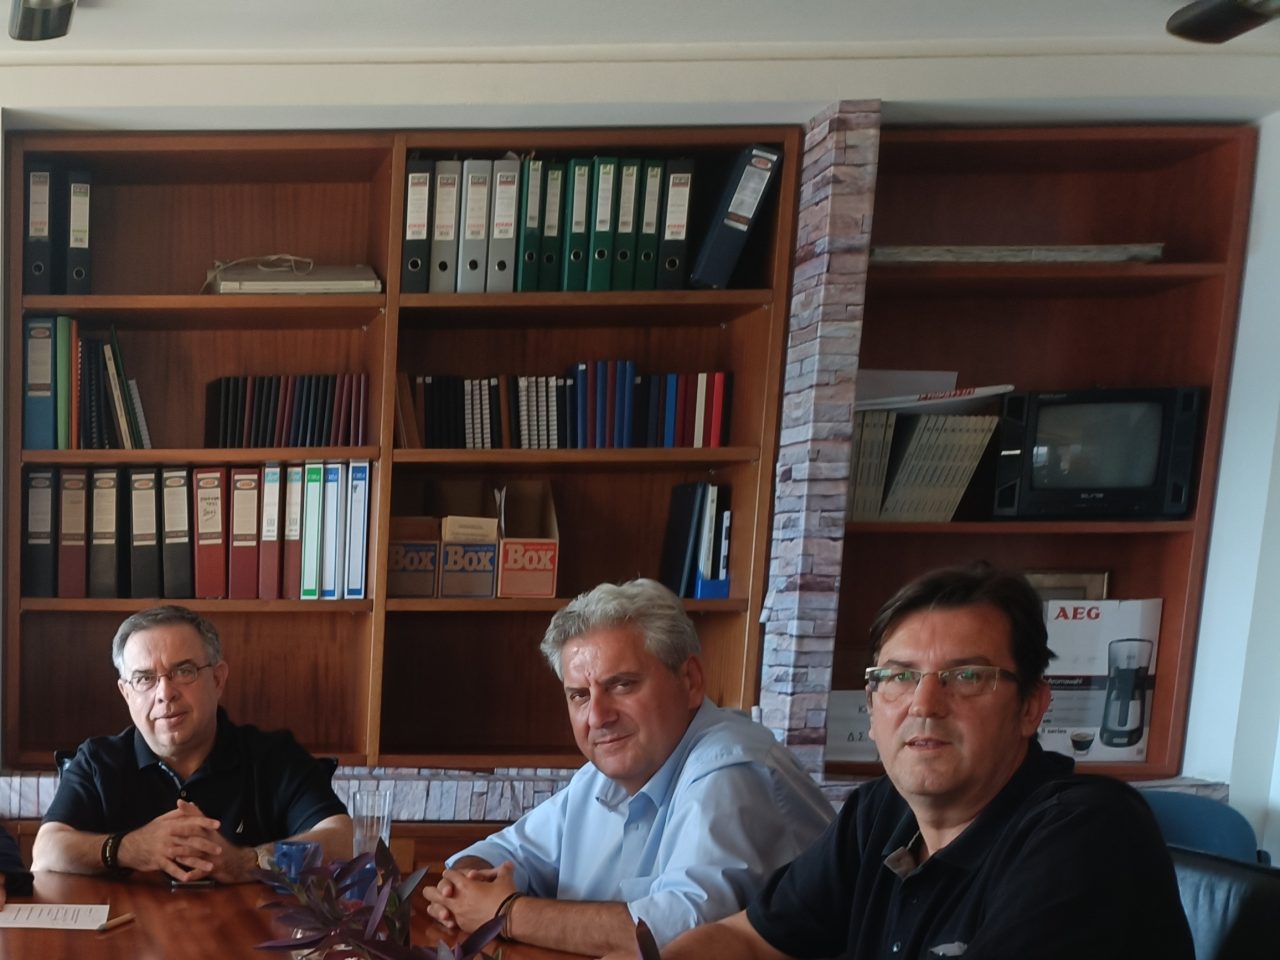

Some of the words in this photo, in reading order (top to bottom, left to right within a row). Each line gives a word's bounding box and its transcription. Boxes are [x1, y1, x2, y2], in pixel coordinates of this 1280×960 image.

[390, 545, 434, 570] Box
[446, 545, 493, 570] Box
[505, 544, 554, 570] Box
[1054, 606, 1101, 621] AEG
